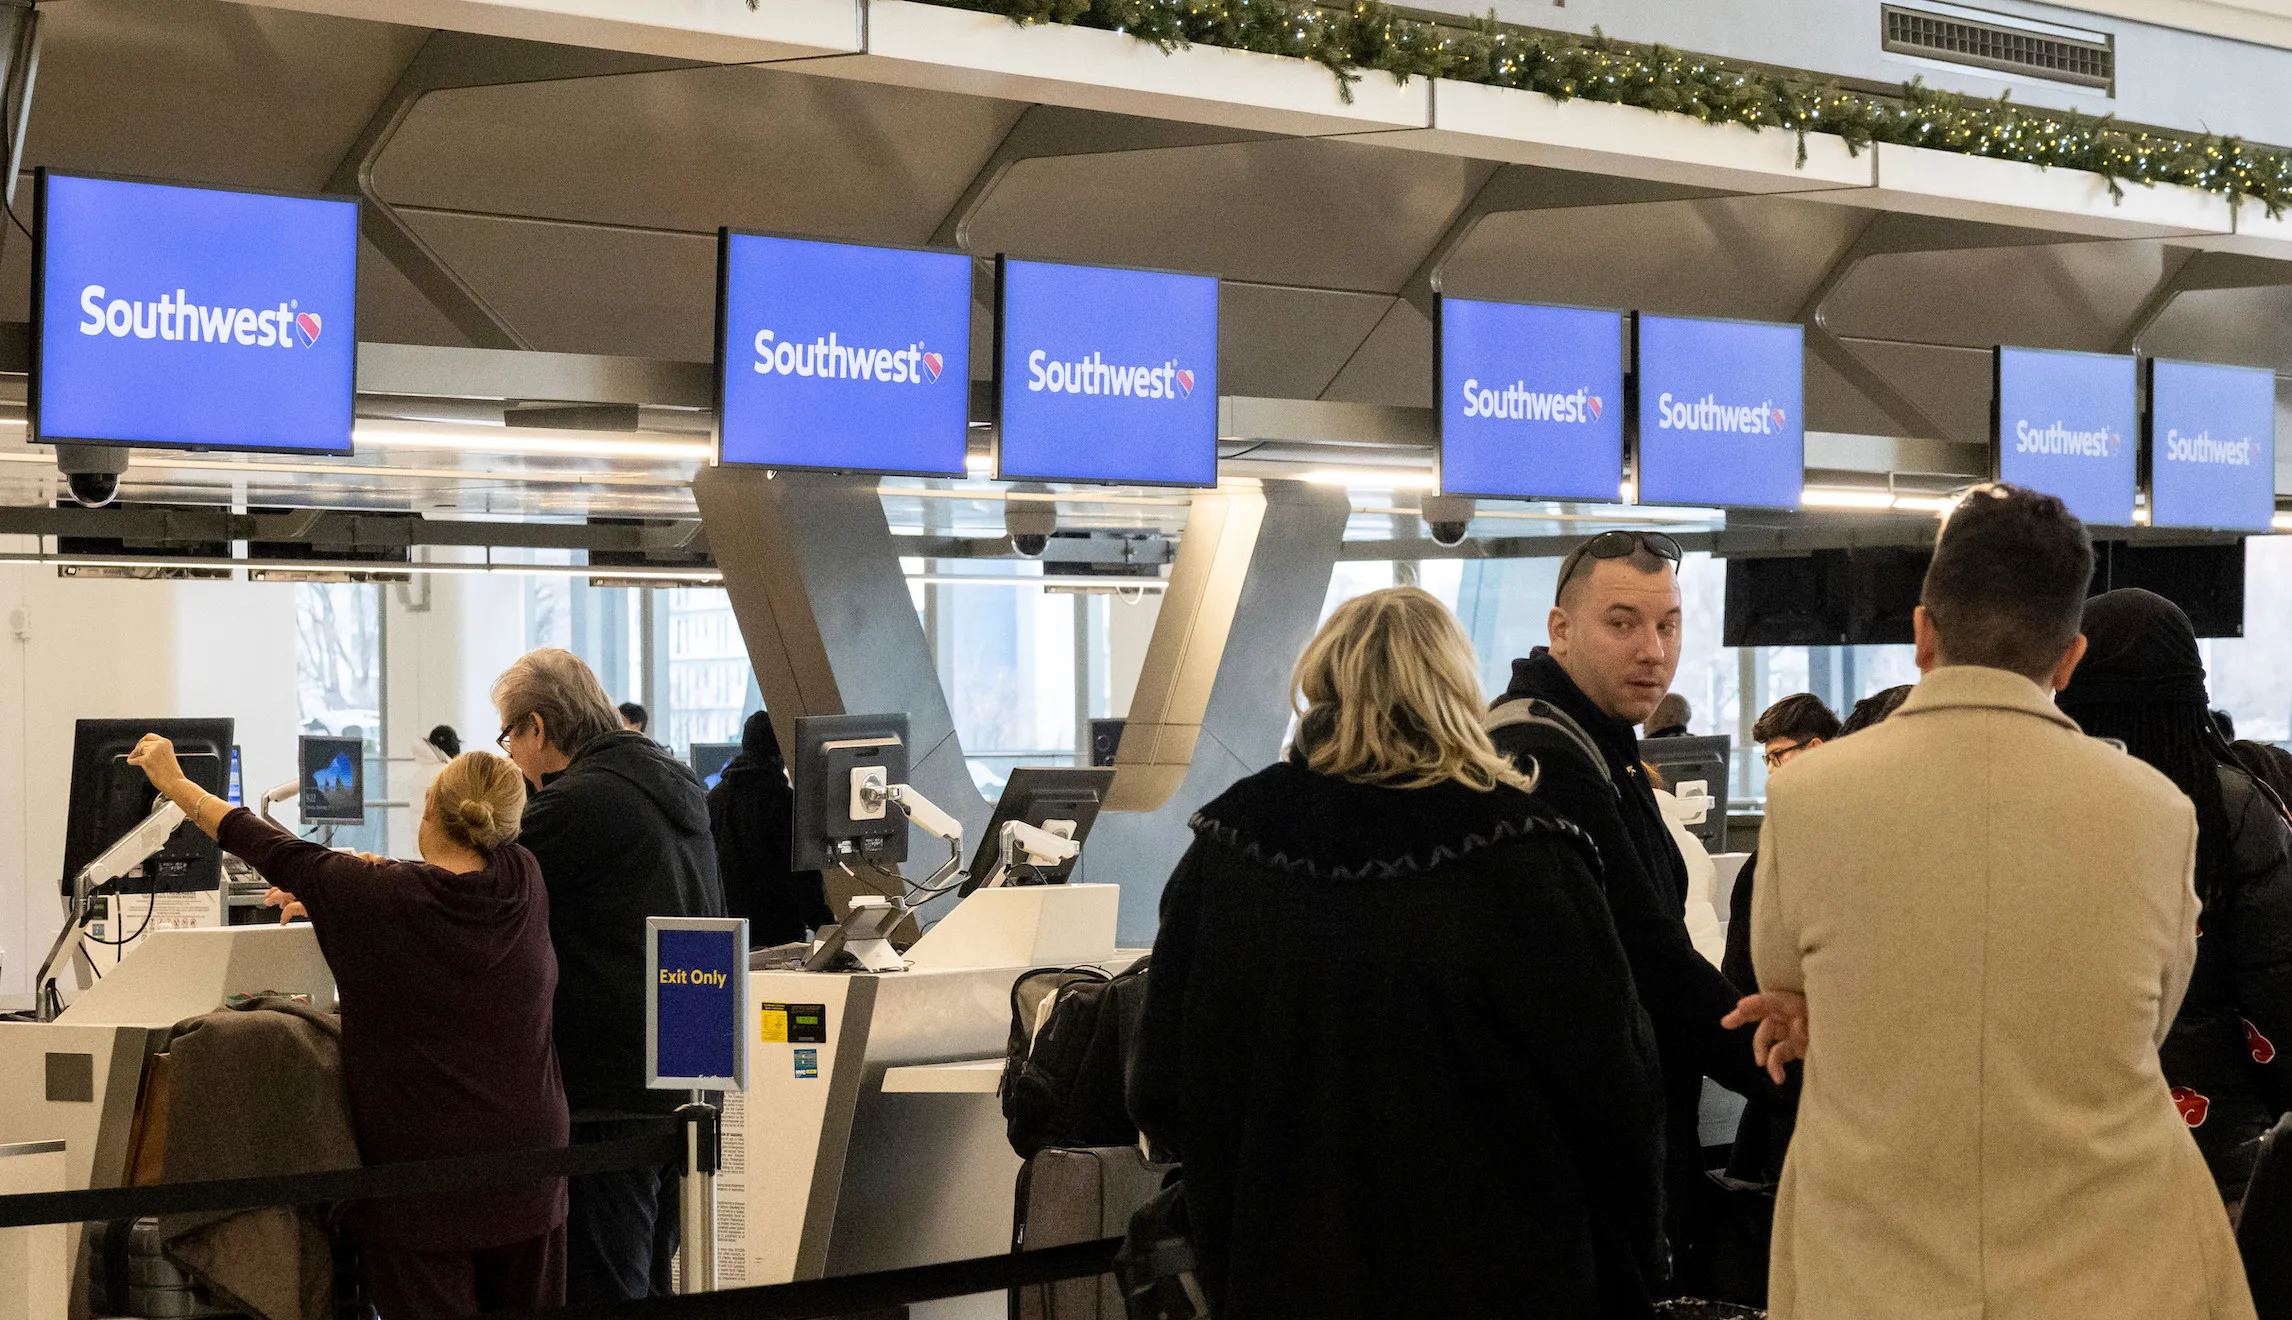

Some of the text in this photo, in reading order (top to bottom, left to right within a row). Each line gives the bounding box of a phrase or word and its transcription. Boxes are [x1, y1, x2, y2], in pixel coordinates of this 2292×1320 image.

[79, 284, 294, 348] Southwest
[754, 329, 921, 384] Southwest
[1028, 350, 1176, 400] Southwest
[1463, 378, 1587, 424] Southwest
[1659, 392, 1771, 435] Southwest
[2016, 419, 2108, 457] Southwest
[2167, 429, 2250, 466] Southwest
[660, 969, 727, 989] Exit Only
